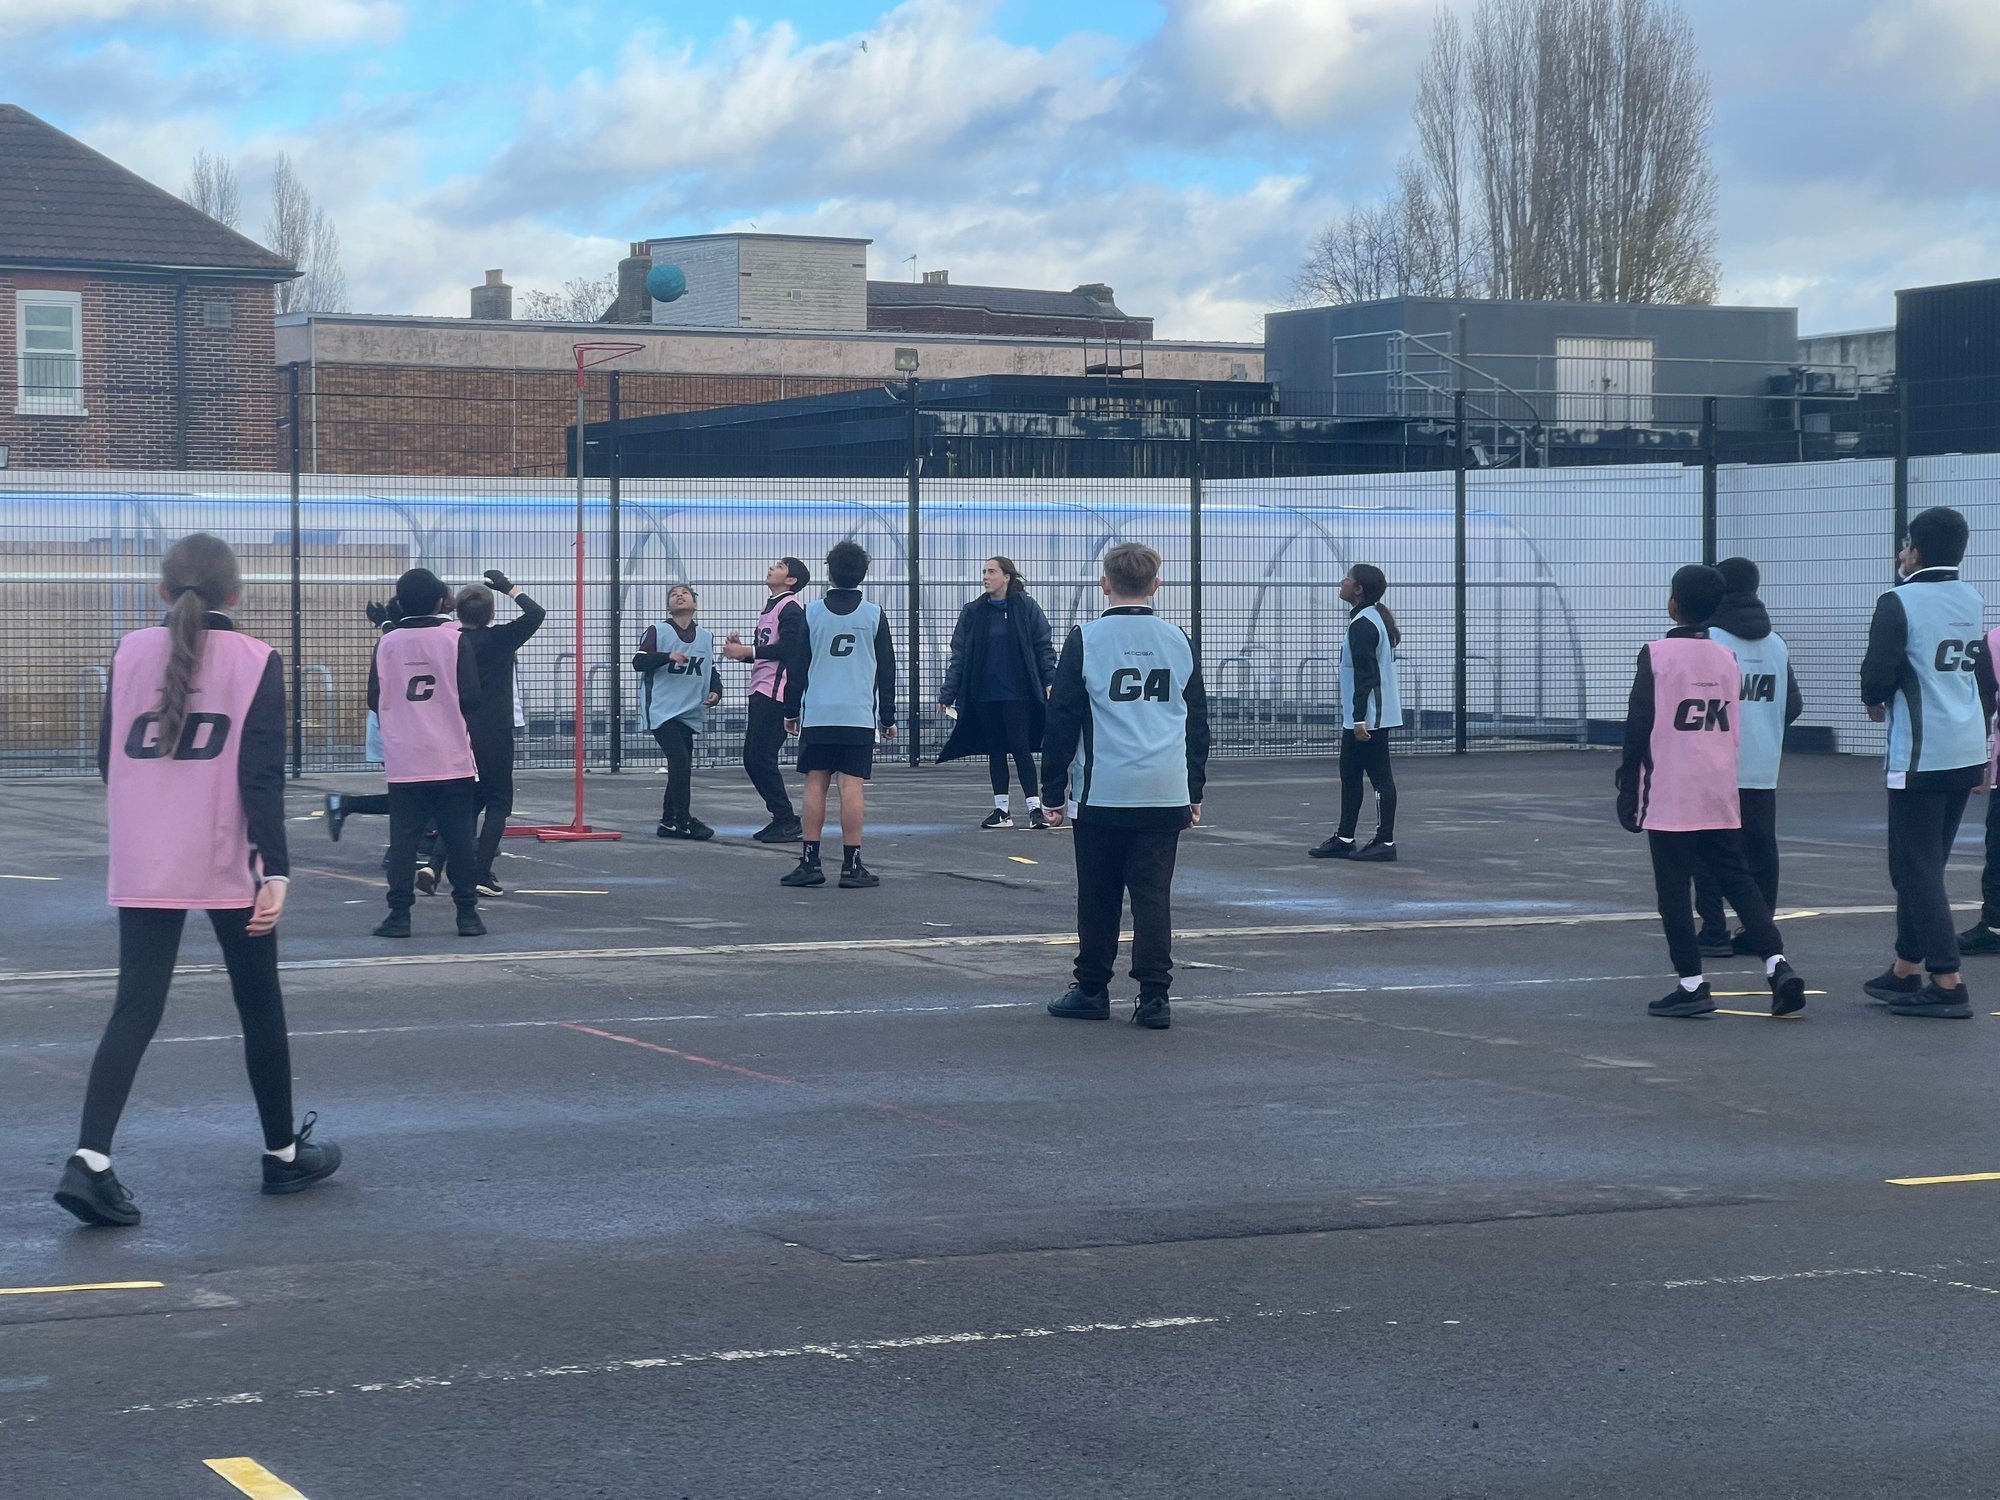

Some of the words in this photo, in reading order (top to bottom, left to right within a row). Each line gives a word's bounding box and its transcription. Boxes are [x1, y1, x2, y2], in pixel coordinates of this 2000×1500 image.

[830, 634, 856, 657] C
[1934, 639, 1980, 672] GS
[406, 675, 436, 701] C
[1109, 668, 1171, 702] GA
[1739, 673, 1776, 702] WA
[1674, 698, 1731, 732] GK
[124, 711, 231, 761] GD
